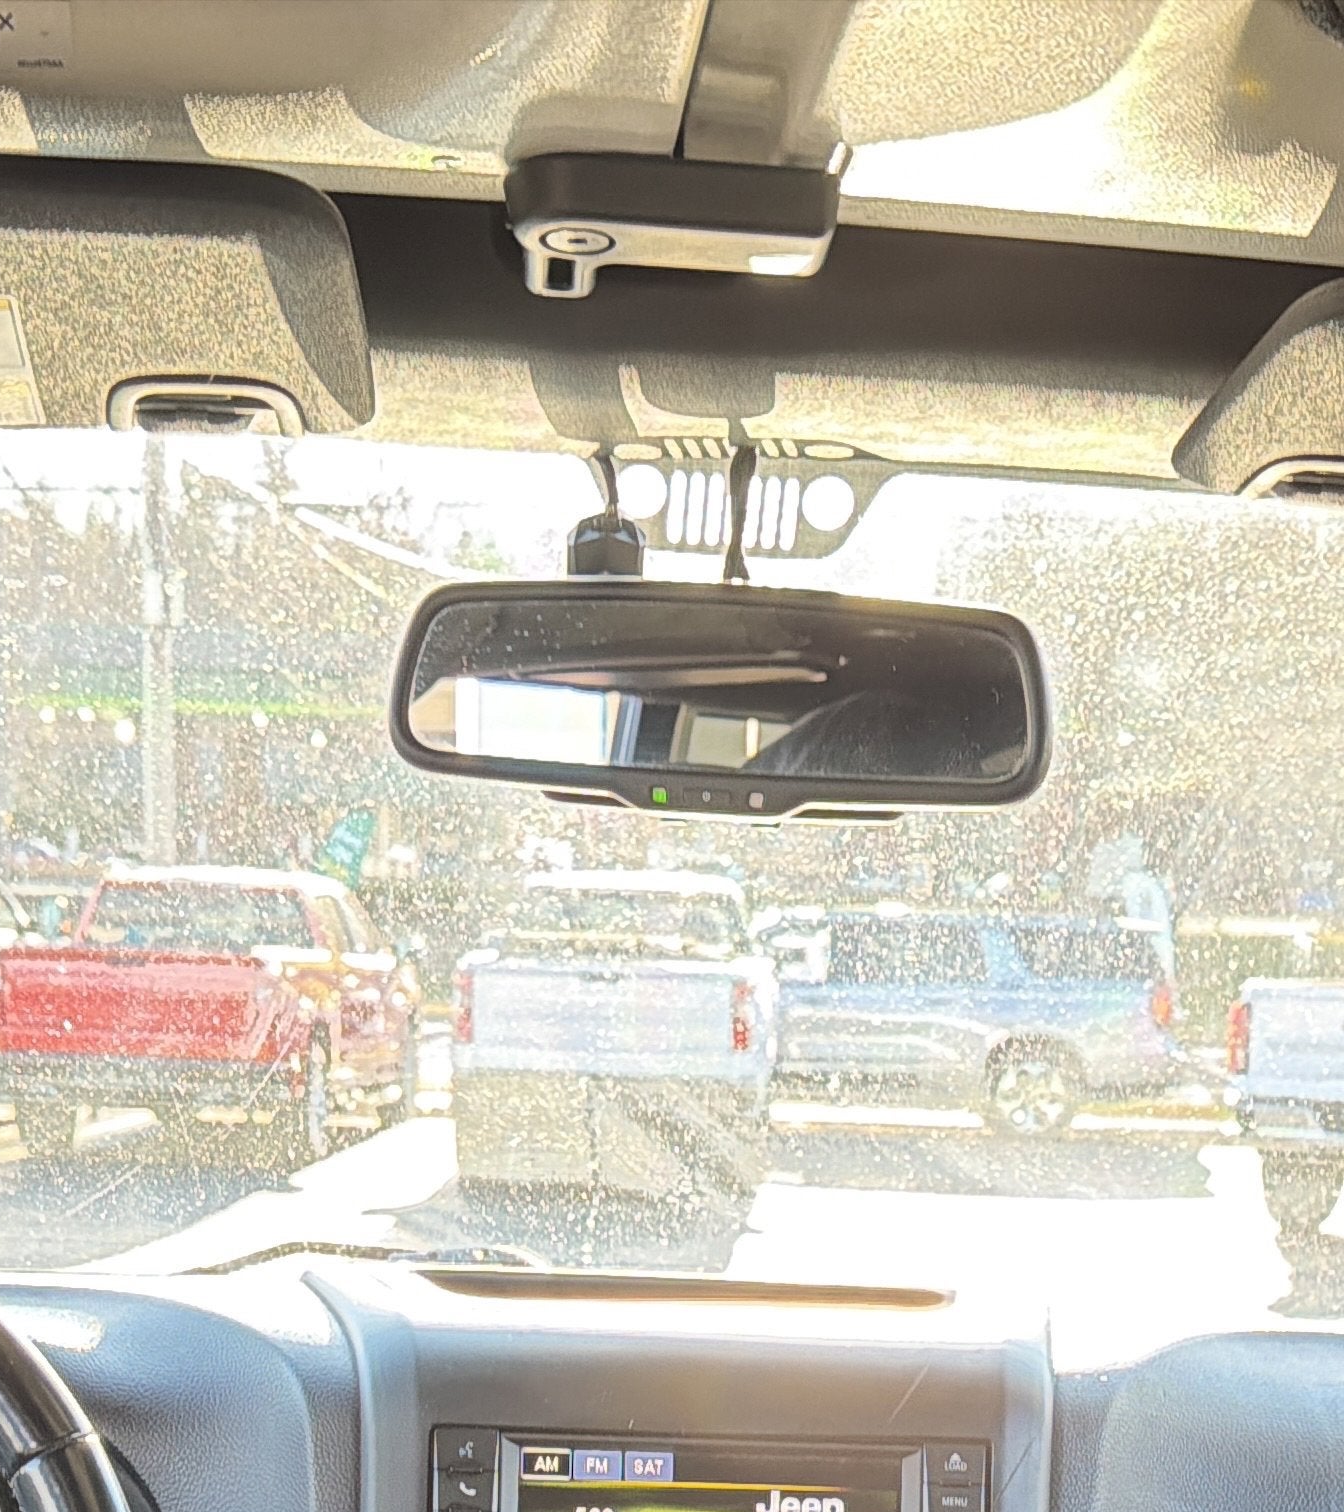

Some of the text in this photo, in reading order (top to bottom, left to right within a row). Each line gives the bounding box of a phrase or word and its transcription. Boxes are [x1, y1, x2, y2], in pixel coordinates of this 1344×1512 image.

[534, 1457, 558, 1472] AM
[585, 1458, 608, 1473] FM
[634, 1459, 663, 1475] SAT
[944, 1461, 967, 1472] LOAD
[942, 1497, 968, 1507] MENU
